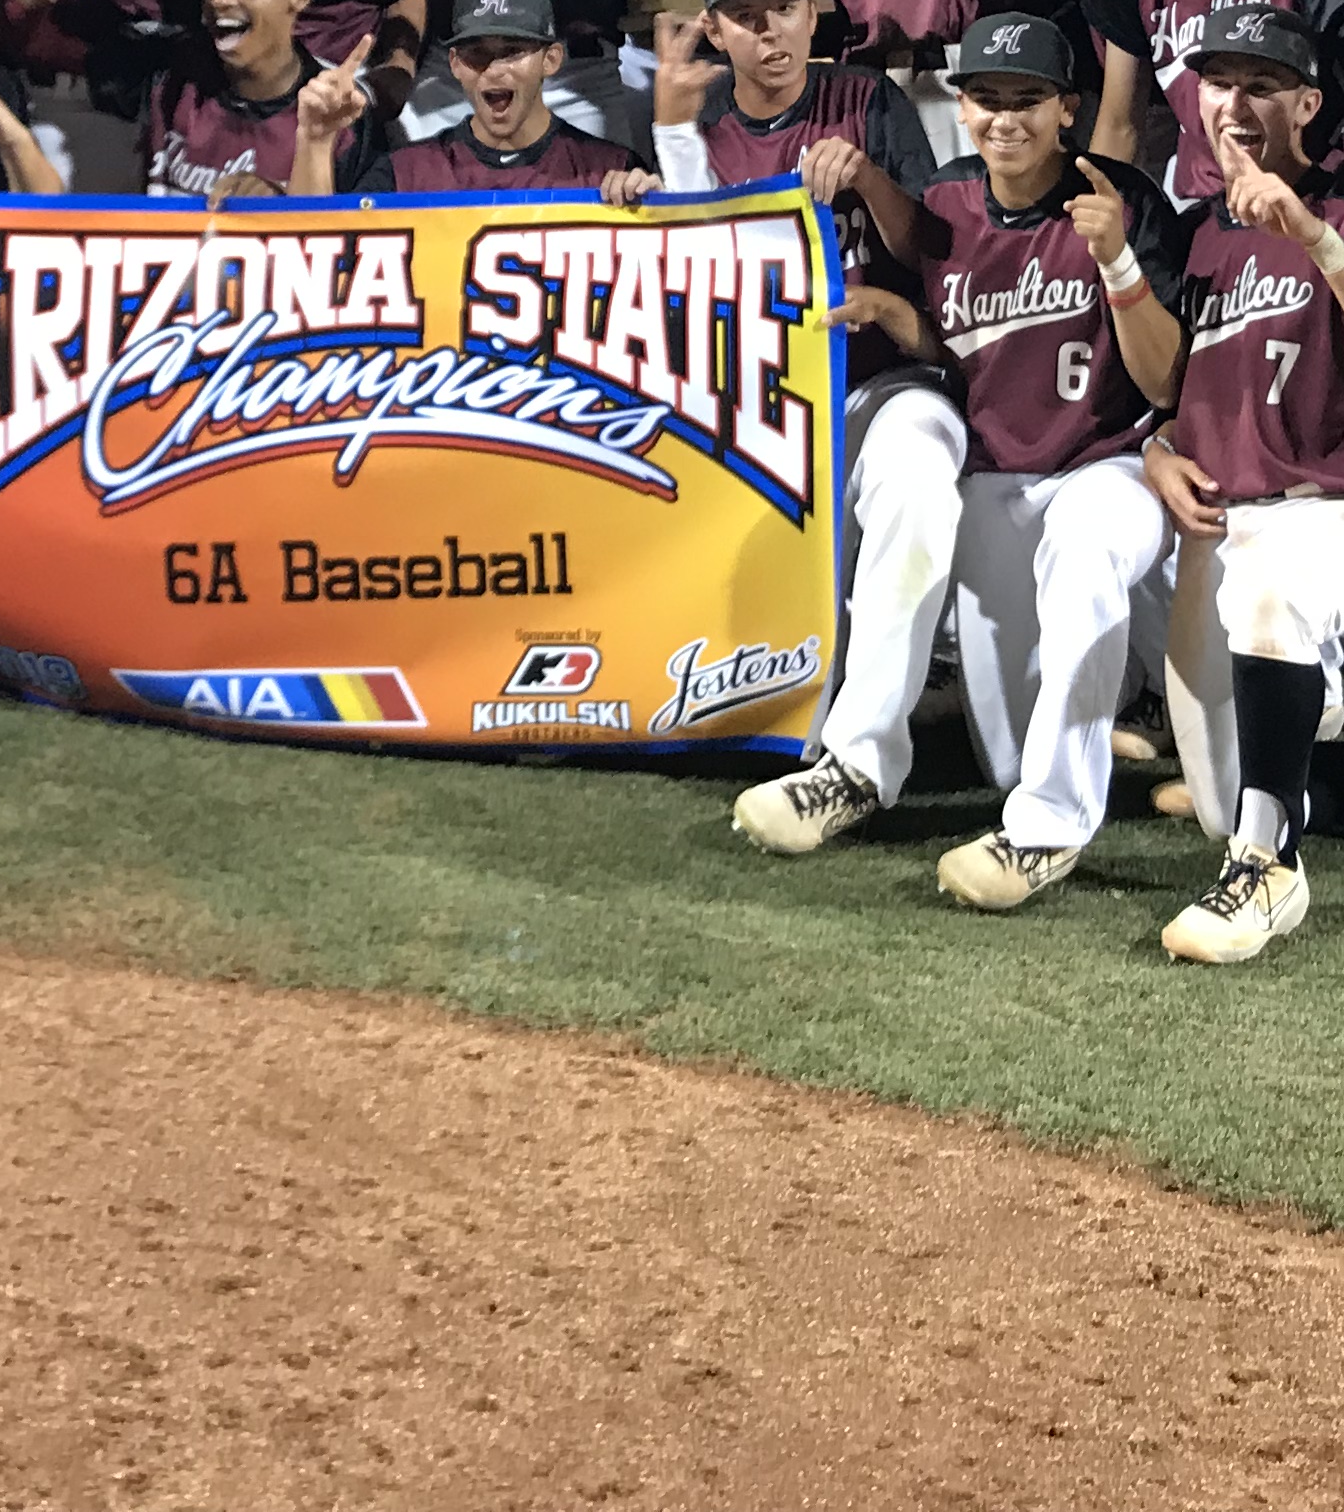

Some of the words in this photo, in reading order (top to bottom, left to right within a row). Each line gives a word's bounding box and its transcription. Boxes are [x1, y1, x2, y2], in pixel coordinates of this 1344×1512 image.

[941, 256, 1098, 332] Hamilton
[465, 213, 811, 504] STATE
[1056, 341, 1093, 401] 6
[1264, 339, 1301, 405] 7
[82, 308, 674, 489] Champions
[164, 541, 249, 605] 6A
[279, 531, 574, 603] Baseball
[182, 677, 296, 718] AIA
[471, 700, 632, 733] KUKULSKI
[648, 638, 816, 735] Jostens
